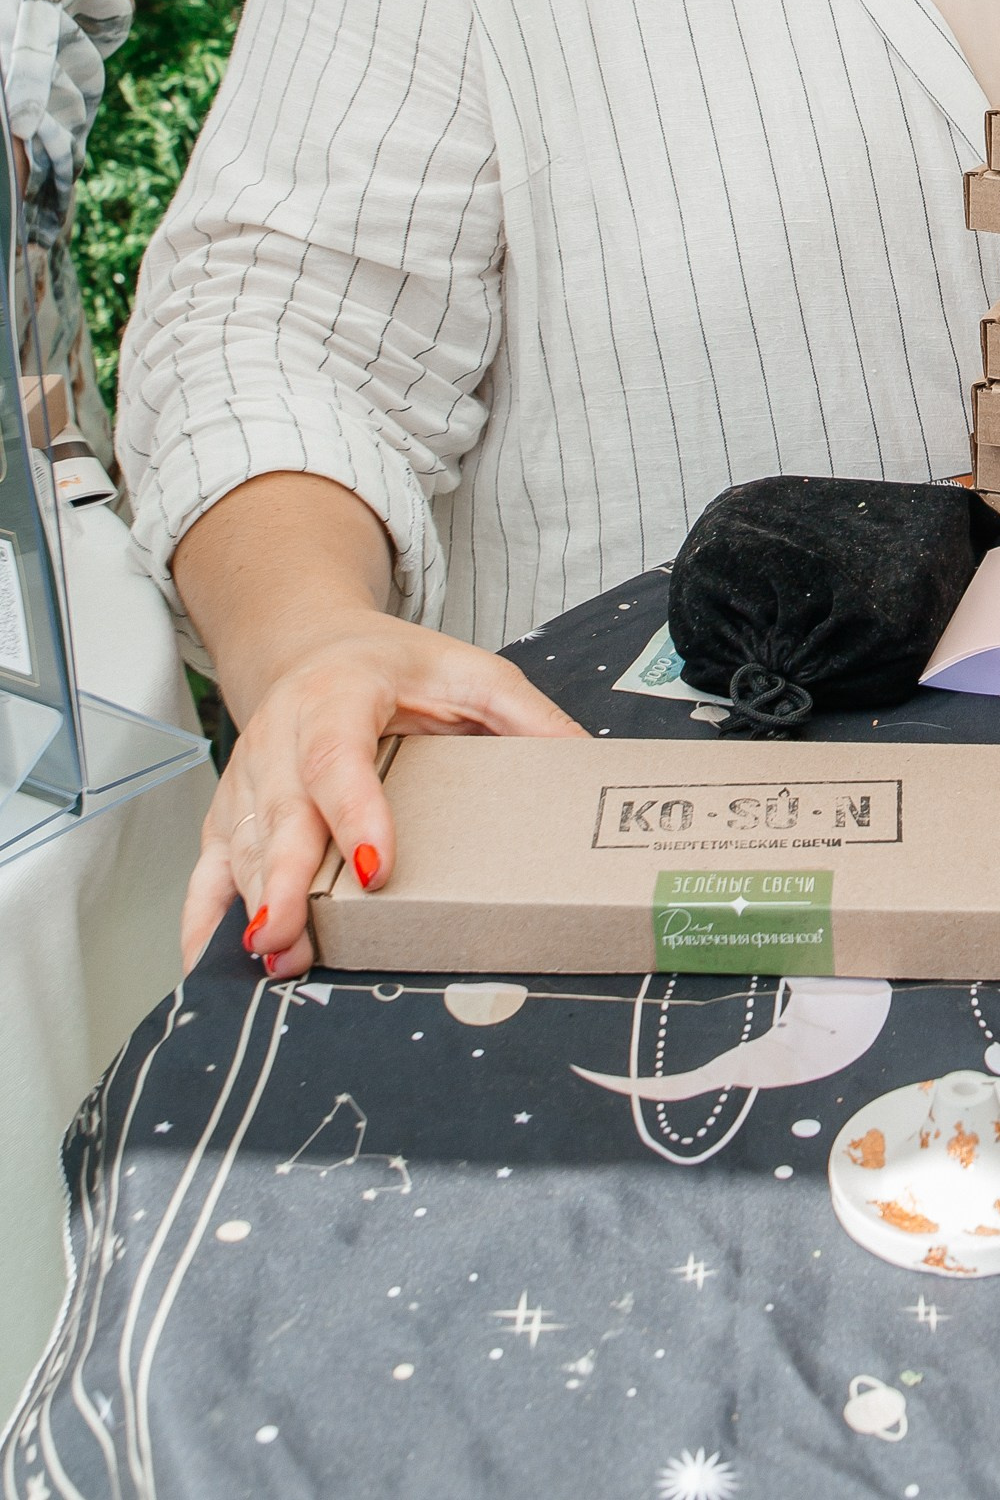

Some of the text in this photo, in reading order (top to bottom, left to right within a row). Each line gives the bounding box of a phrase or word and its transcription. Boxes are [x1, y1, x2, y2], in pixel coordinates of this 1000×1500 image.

[644, 657, 672, 682] 1000
[652, 837, 843, 851] ЭНЕРГЕТИЧЕСКИЕ СВЕЧИ
[672, 873, 815, 893] ЗЕЛЁНЫЕ СВЕЧИ
[657, 908, 714, 938] Для
[662, 931, 823, 950] привлечения финансов
